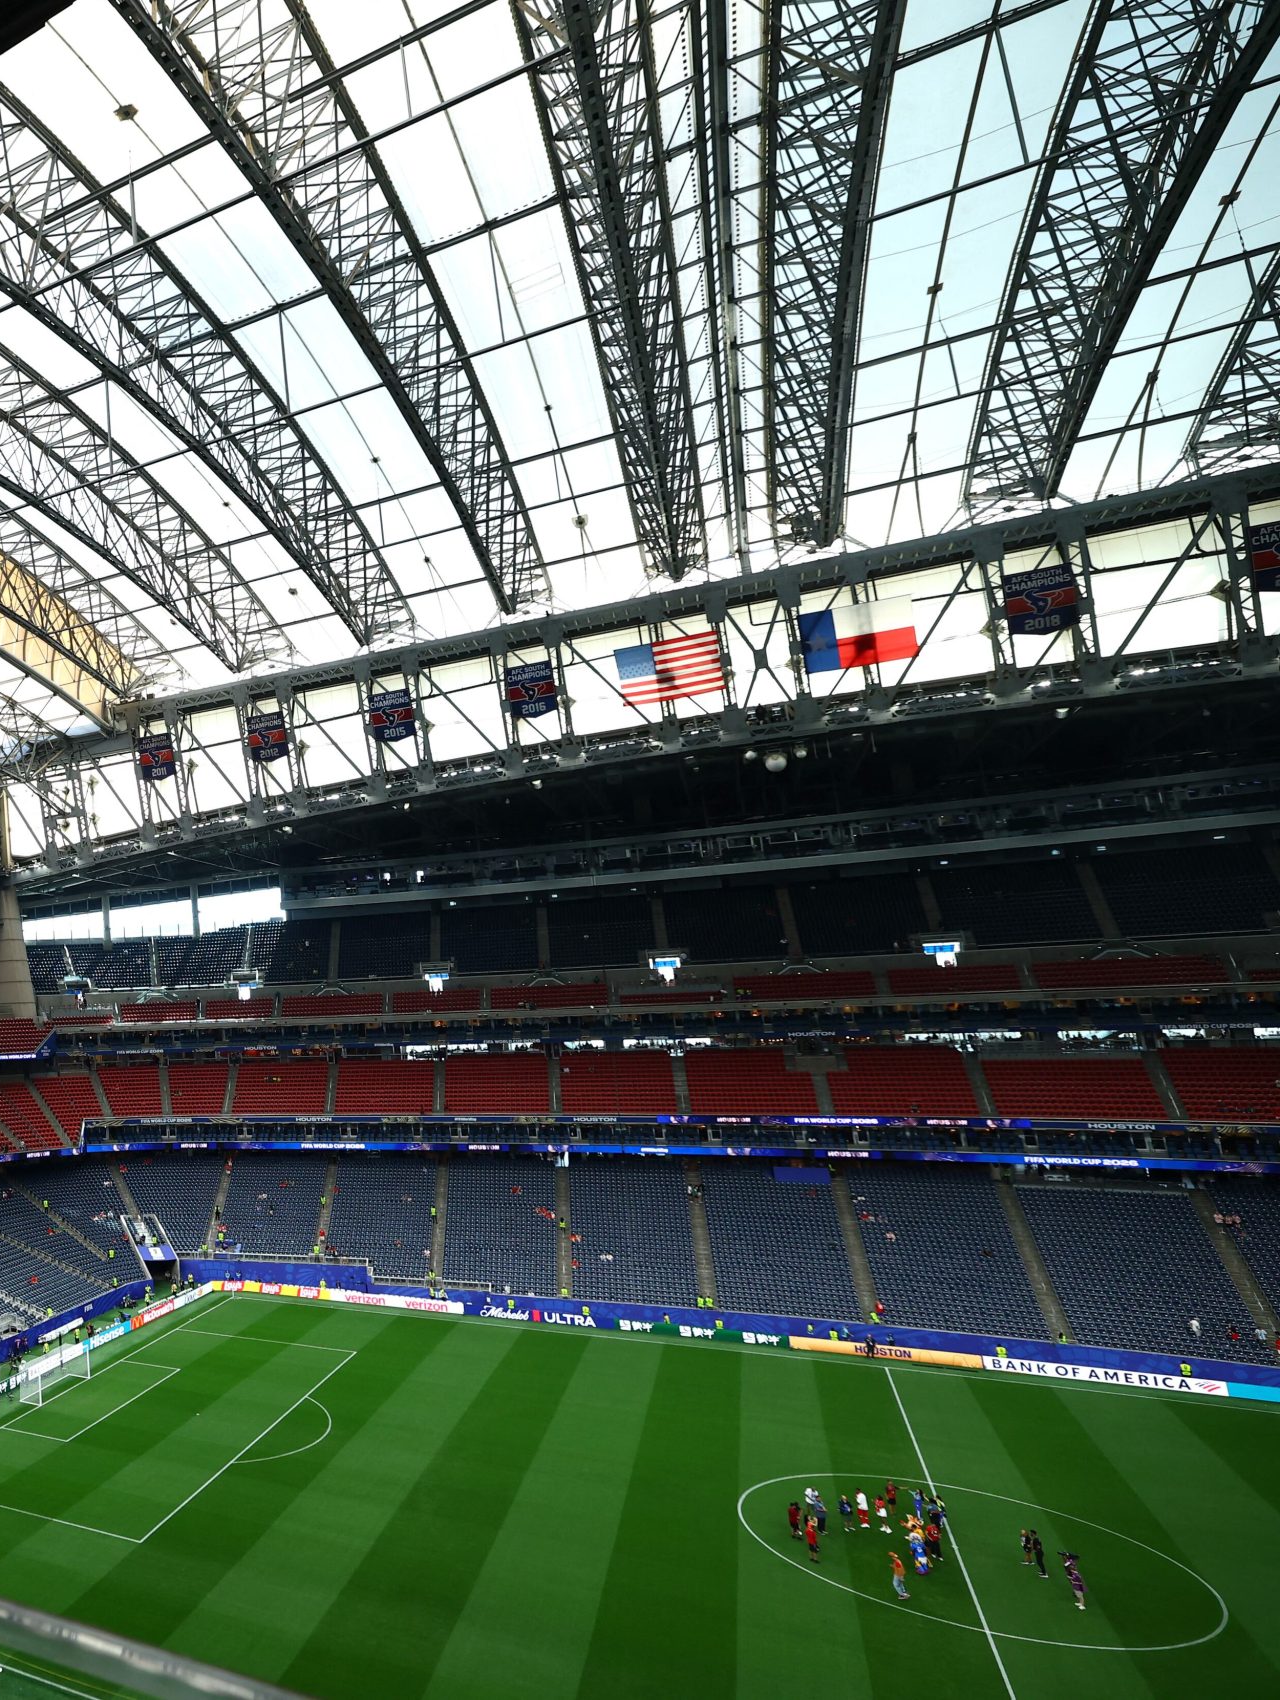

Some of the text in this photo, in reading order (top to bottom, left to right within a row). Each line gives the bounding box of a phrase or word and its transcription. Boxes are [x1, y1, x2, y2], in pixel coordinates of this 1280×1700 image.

[1011, 568, 1062, 583] AFC SOUTH
[1005, 573, 1071, 592] CHAMPIONS
[1024, 615, 1060, 631] 2018
[524, 664, 545, 672] SOUTH
[507, 669, 550, 682] CHAMPIONS
[370, 697, 408, 708] CHAMPIONS
[522, 702, 546, 714] 2016
[384, 727, 406, 738] 2015
[260, 748, 279, 758] 2012
[1045, 1157, 1080, 1165] WORLD
[1102, 1159, 1139, 1167] 2026
[345, 1293, 385, 1305] verizon
[405, 1299, 448, 1312] verizon
[480, 1305, 597, 1328] Michelob ULTRA
[90, 1325, 125, 1350] Hisense
[991, 1358, 1192, 1390] BANK OF AMERICA
